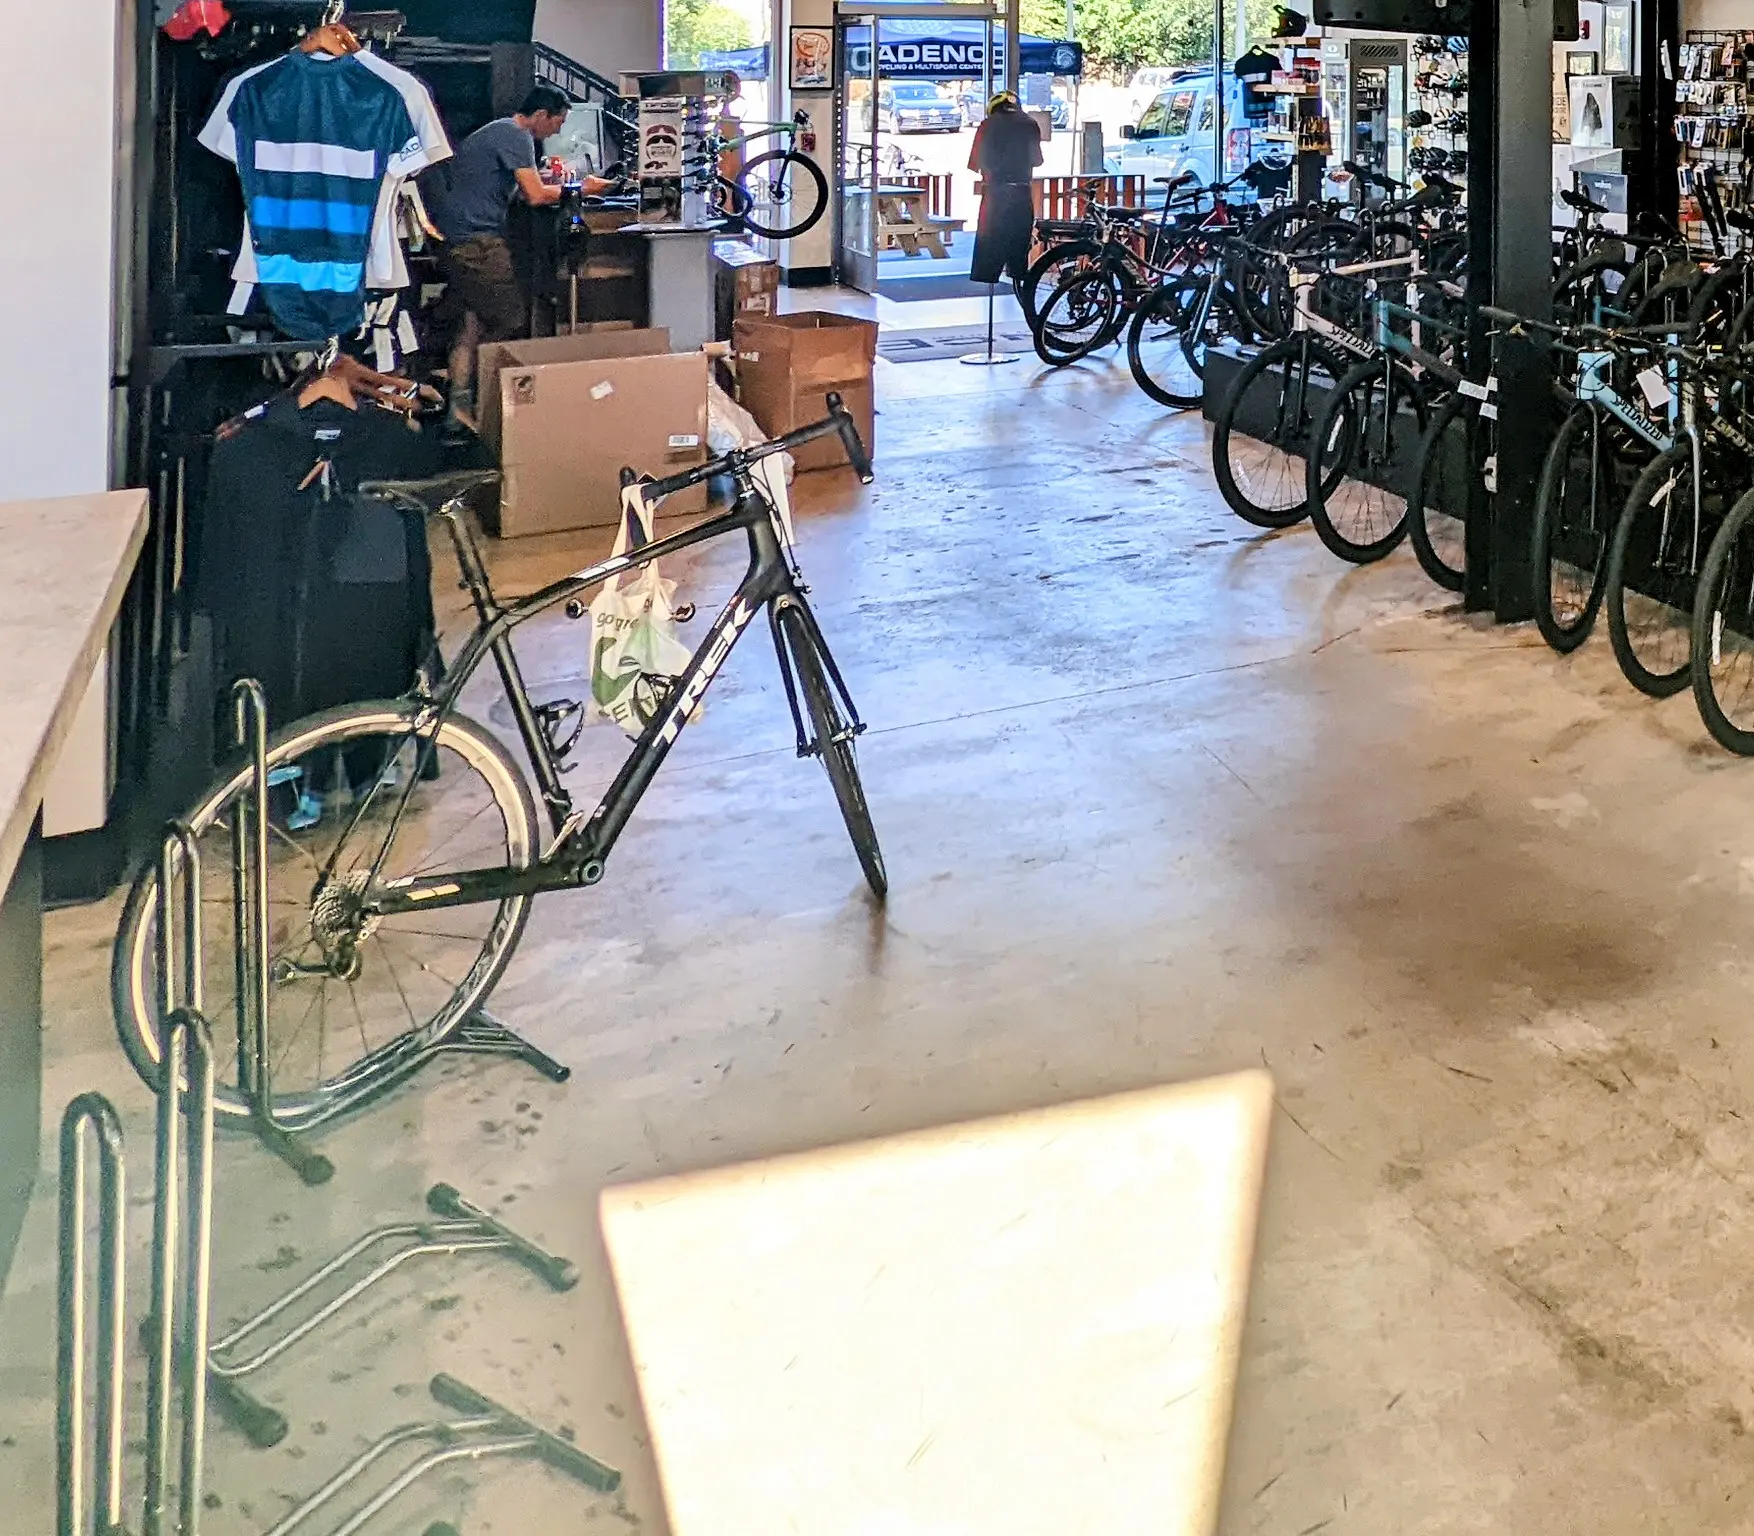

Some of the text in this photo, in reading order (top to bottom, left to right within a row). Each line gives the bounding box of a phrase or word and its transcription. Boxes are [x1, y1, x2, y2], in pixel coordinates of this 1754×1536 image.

[1611, 394, 1663, 442] SPECIALIZED
[596, 612, 615, 628] go
[652, 598, 754, 748] TREK
